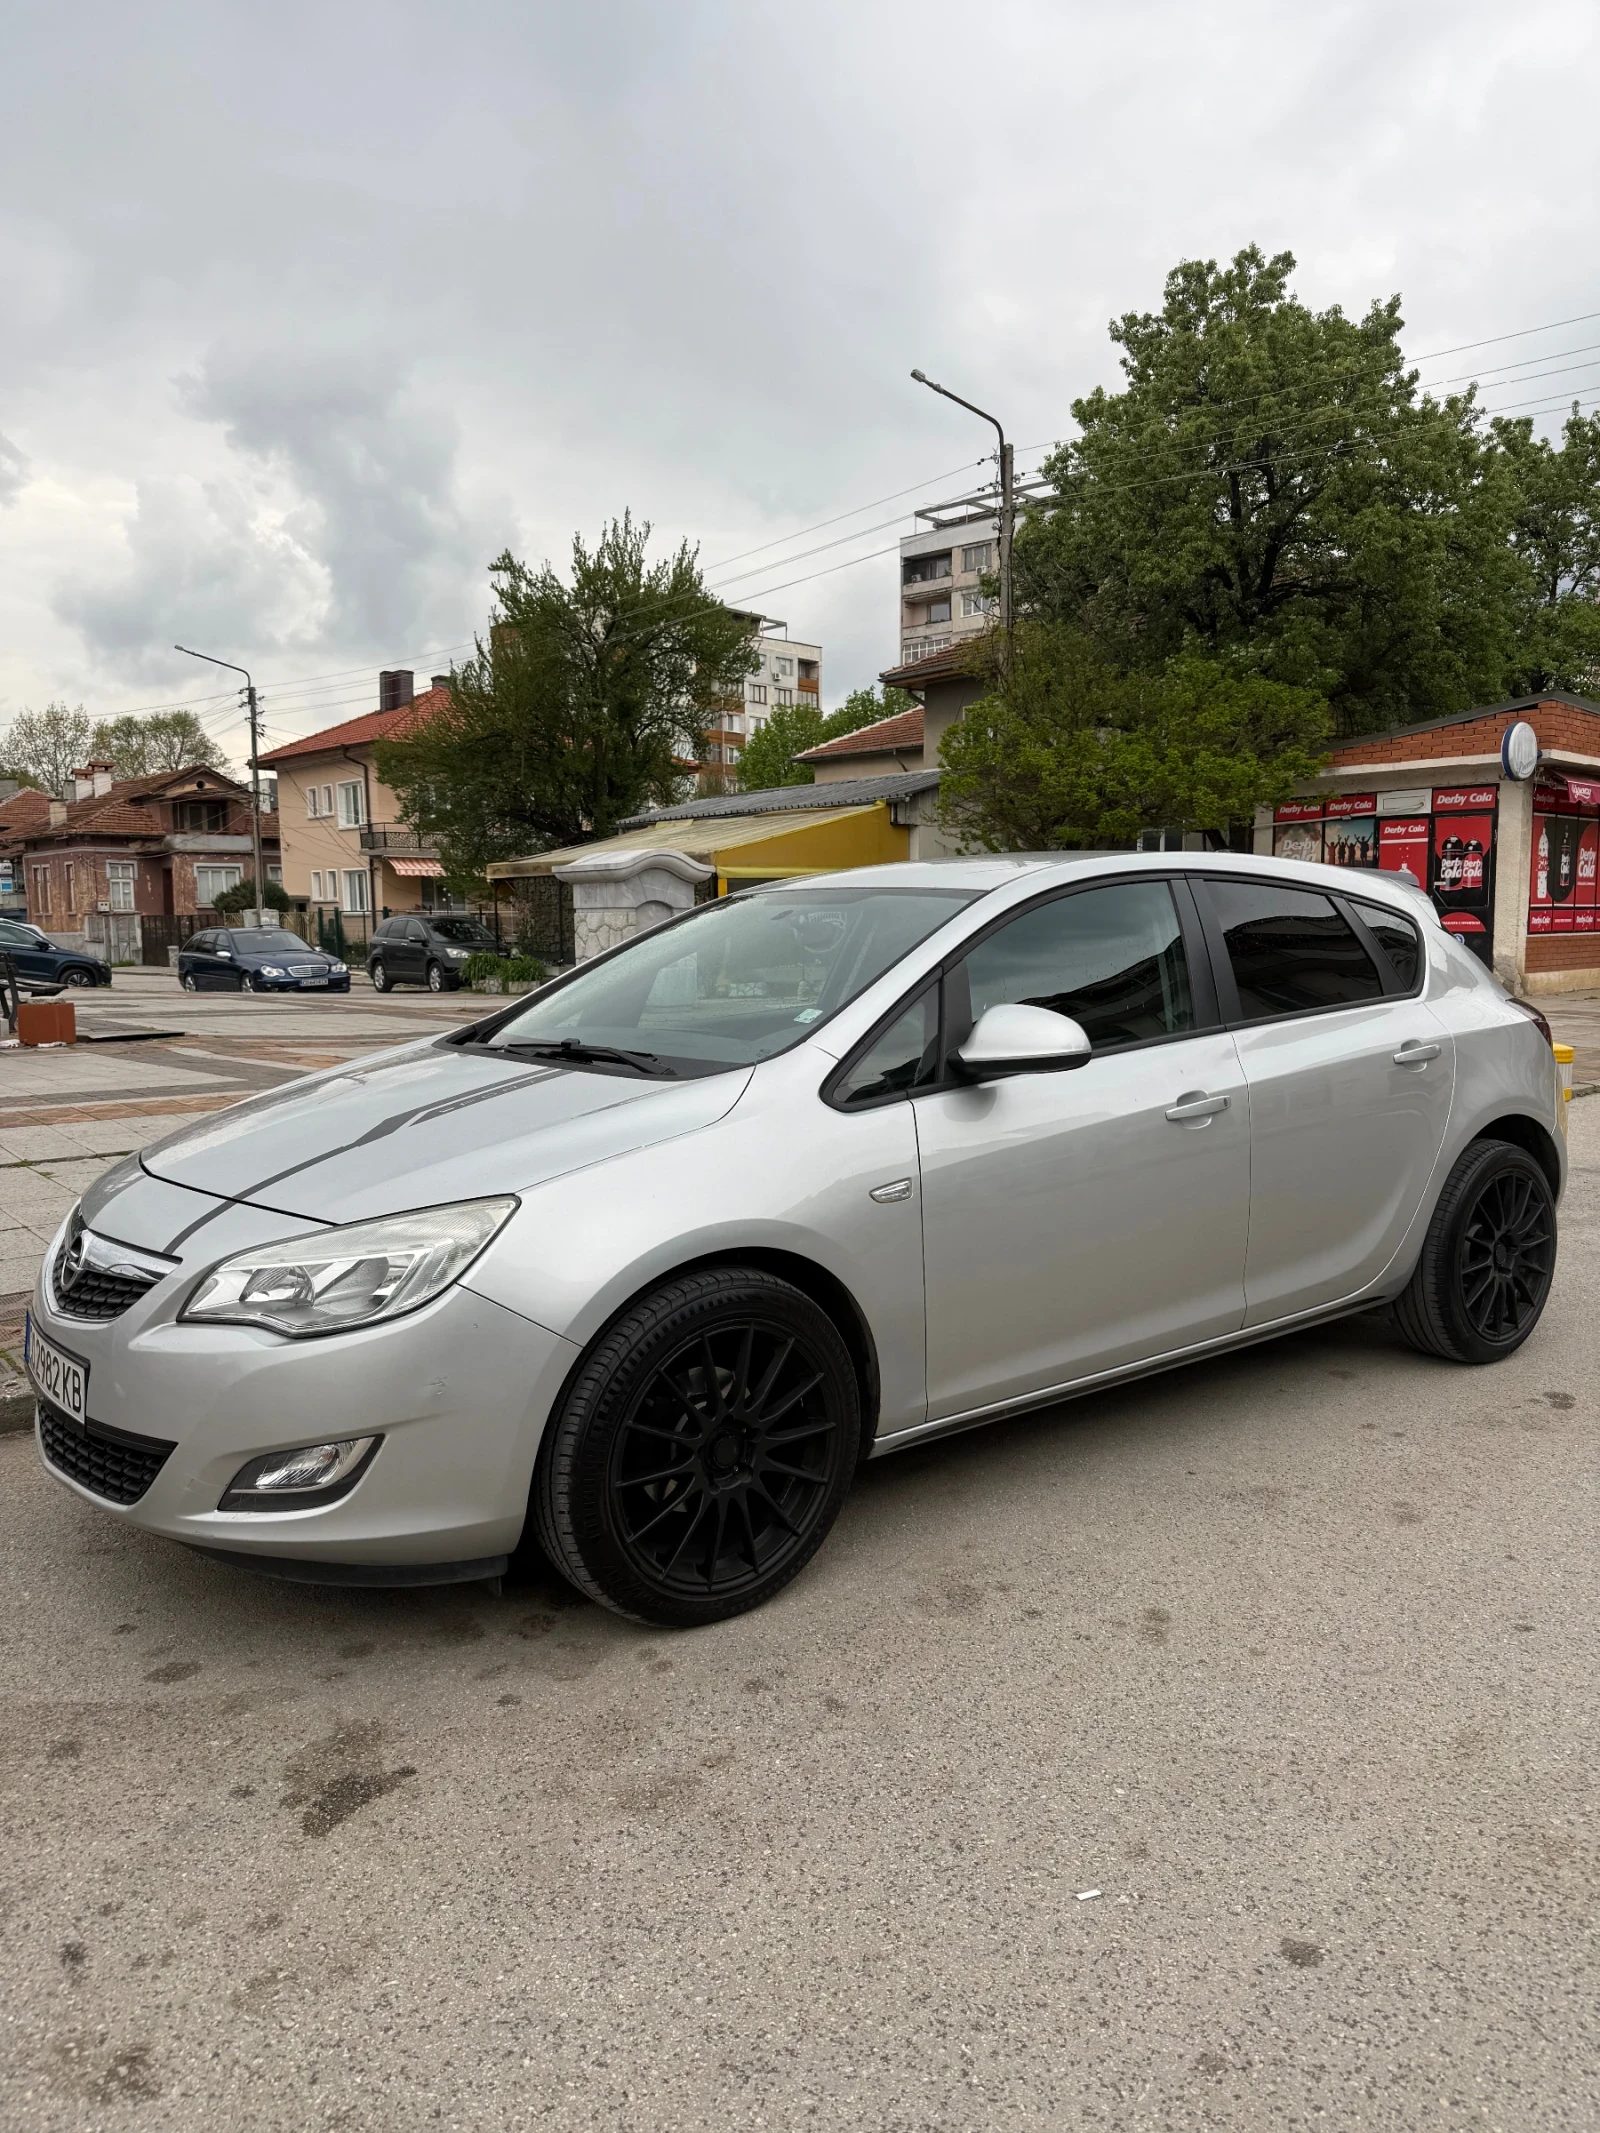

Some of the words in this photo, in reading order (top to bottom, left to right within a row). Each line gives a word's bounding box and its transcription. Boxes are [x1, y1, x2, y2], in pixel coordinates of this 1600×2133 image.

[1436, 793, 1467, 805] Derby
[1469, 792, 1492, 802] Cola
[1280, 804, 1302, 814] Derby
[1329, 802, 1352, 812] Derby
[1354, 800, 1372, 809] Cola
[1384, 825, 1407, 835] Derby
[1408, 824, 1425, 833] Cola
[1283, 838, 1319, 852] Derby
[1580, 847, 1597, 864] Derby
[1440, 865, 1462, 878] Cola
[1462, 865, 1483, 877] Cola
[1578, 860, 1595, 877] Cola
[62, 1361, 82, 1414] KB
